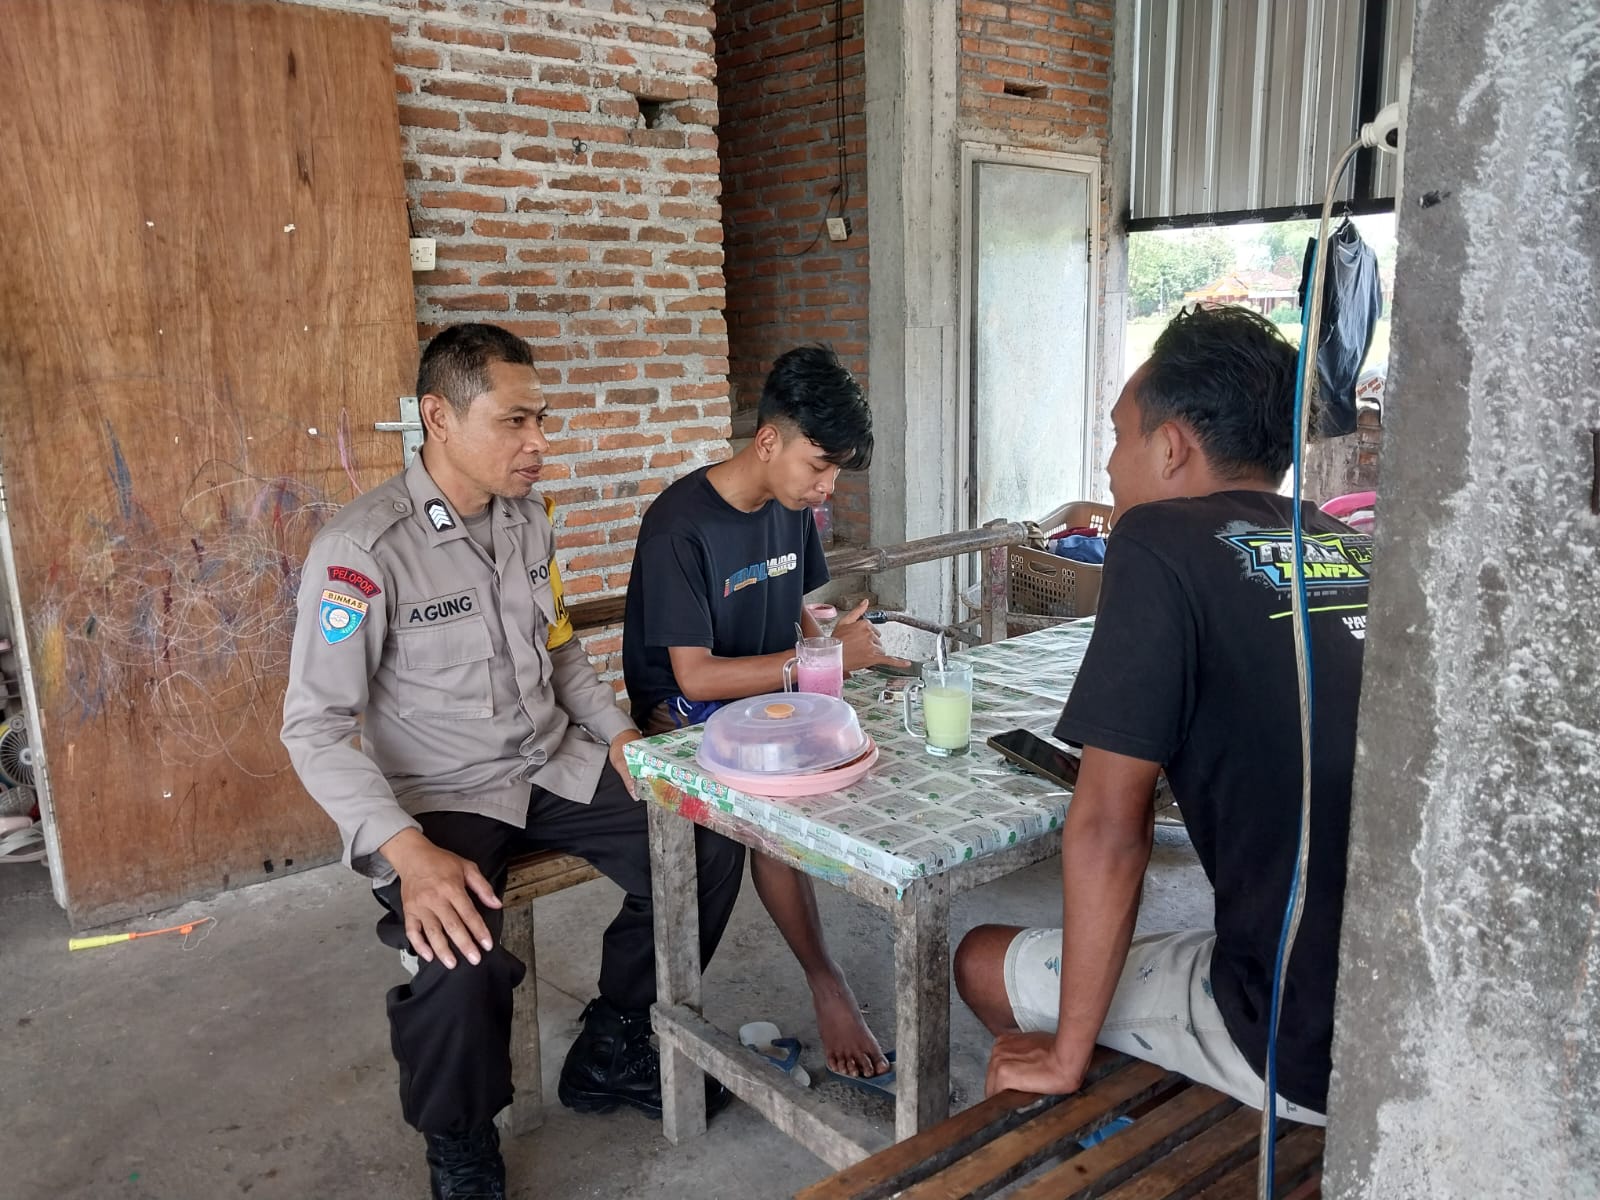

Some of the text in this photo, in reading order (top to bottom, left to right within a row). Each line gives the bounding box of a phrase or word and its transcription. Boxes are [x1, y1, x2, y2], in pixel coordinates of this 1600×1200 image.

[333, 569, 373, 594] PELOPOR
[327, 592, 363, 609] BINMAS
[409, 596, 472, 623] AGUNG
